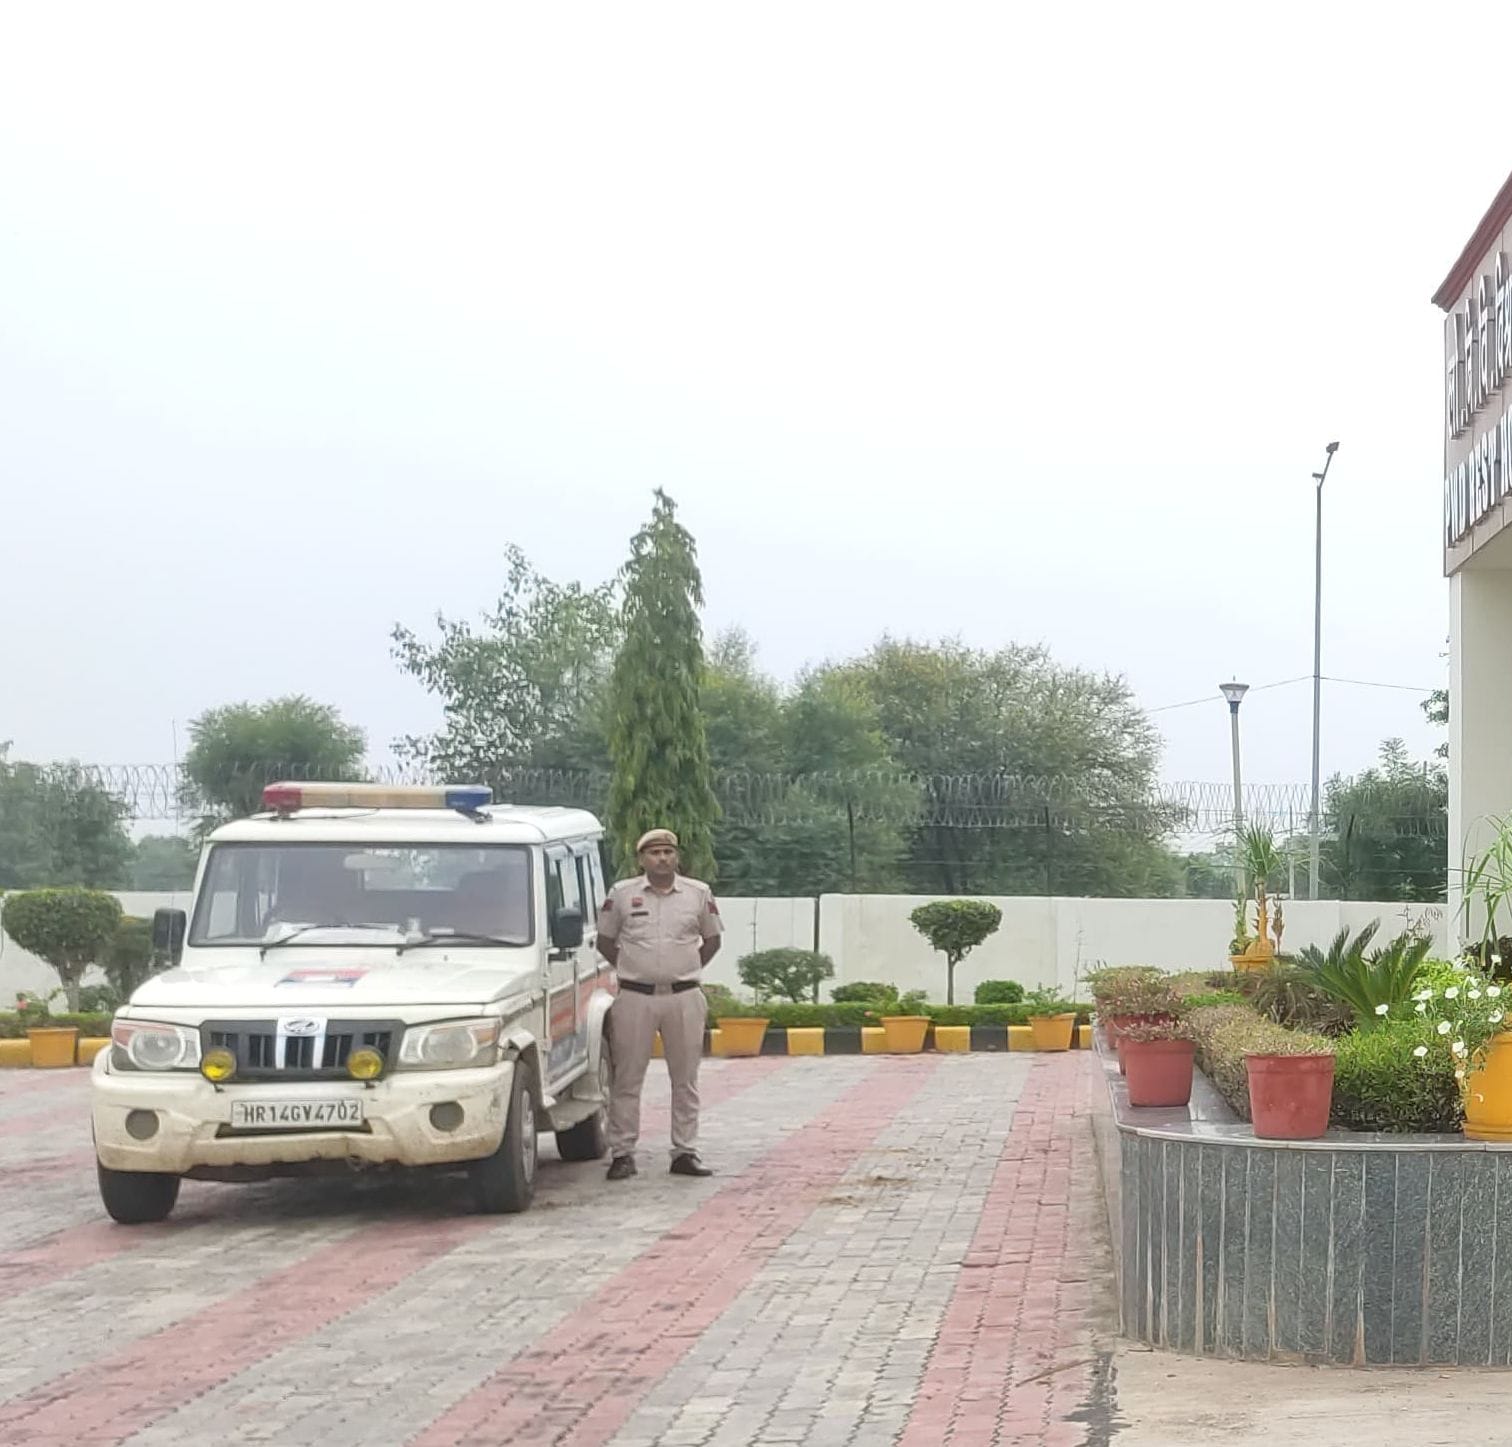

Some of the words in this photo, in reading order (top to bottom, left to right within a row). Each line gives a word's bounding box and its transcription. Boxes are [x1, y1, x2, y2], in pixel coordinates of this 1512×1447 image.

[1444, 461, 1466, 549] PWD
[1468, 424, 1497, 528] REST
[243, 1102, 360, 1124] HR14GV4702
